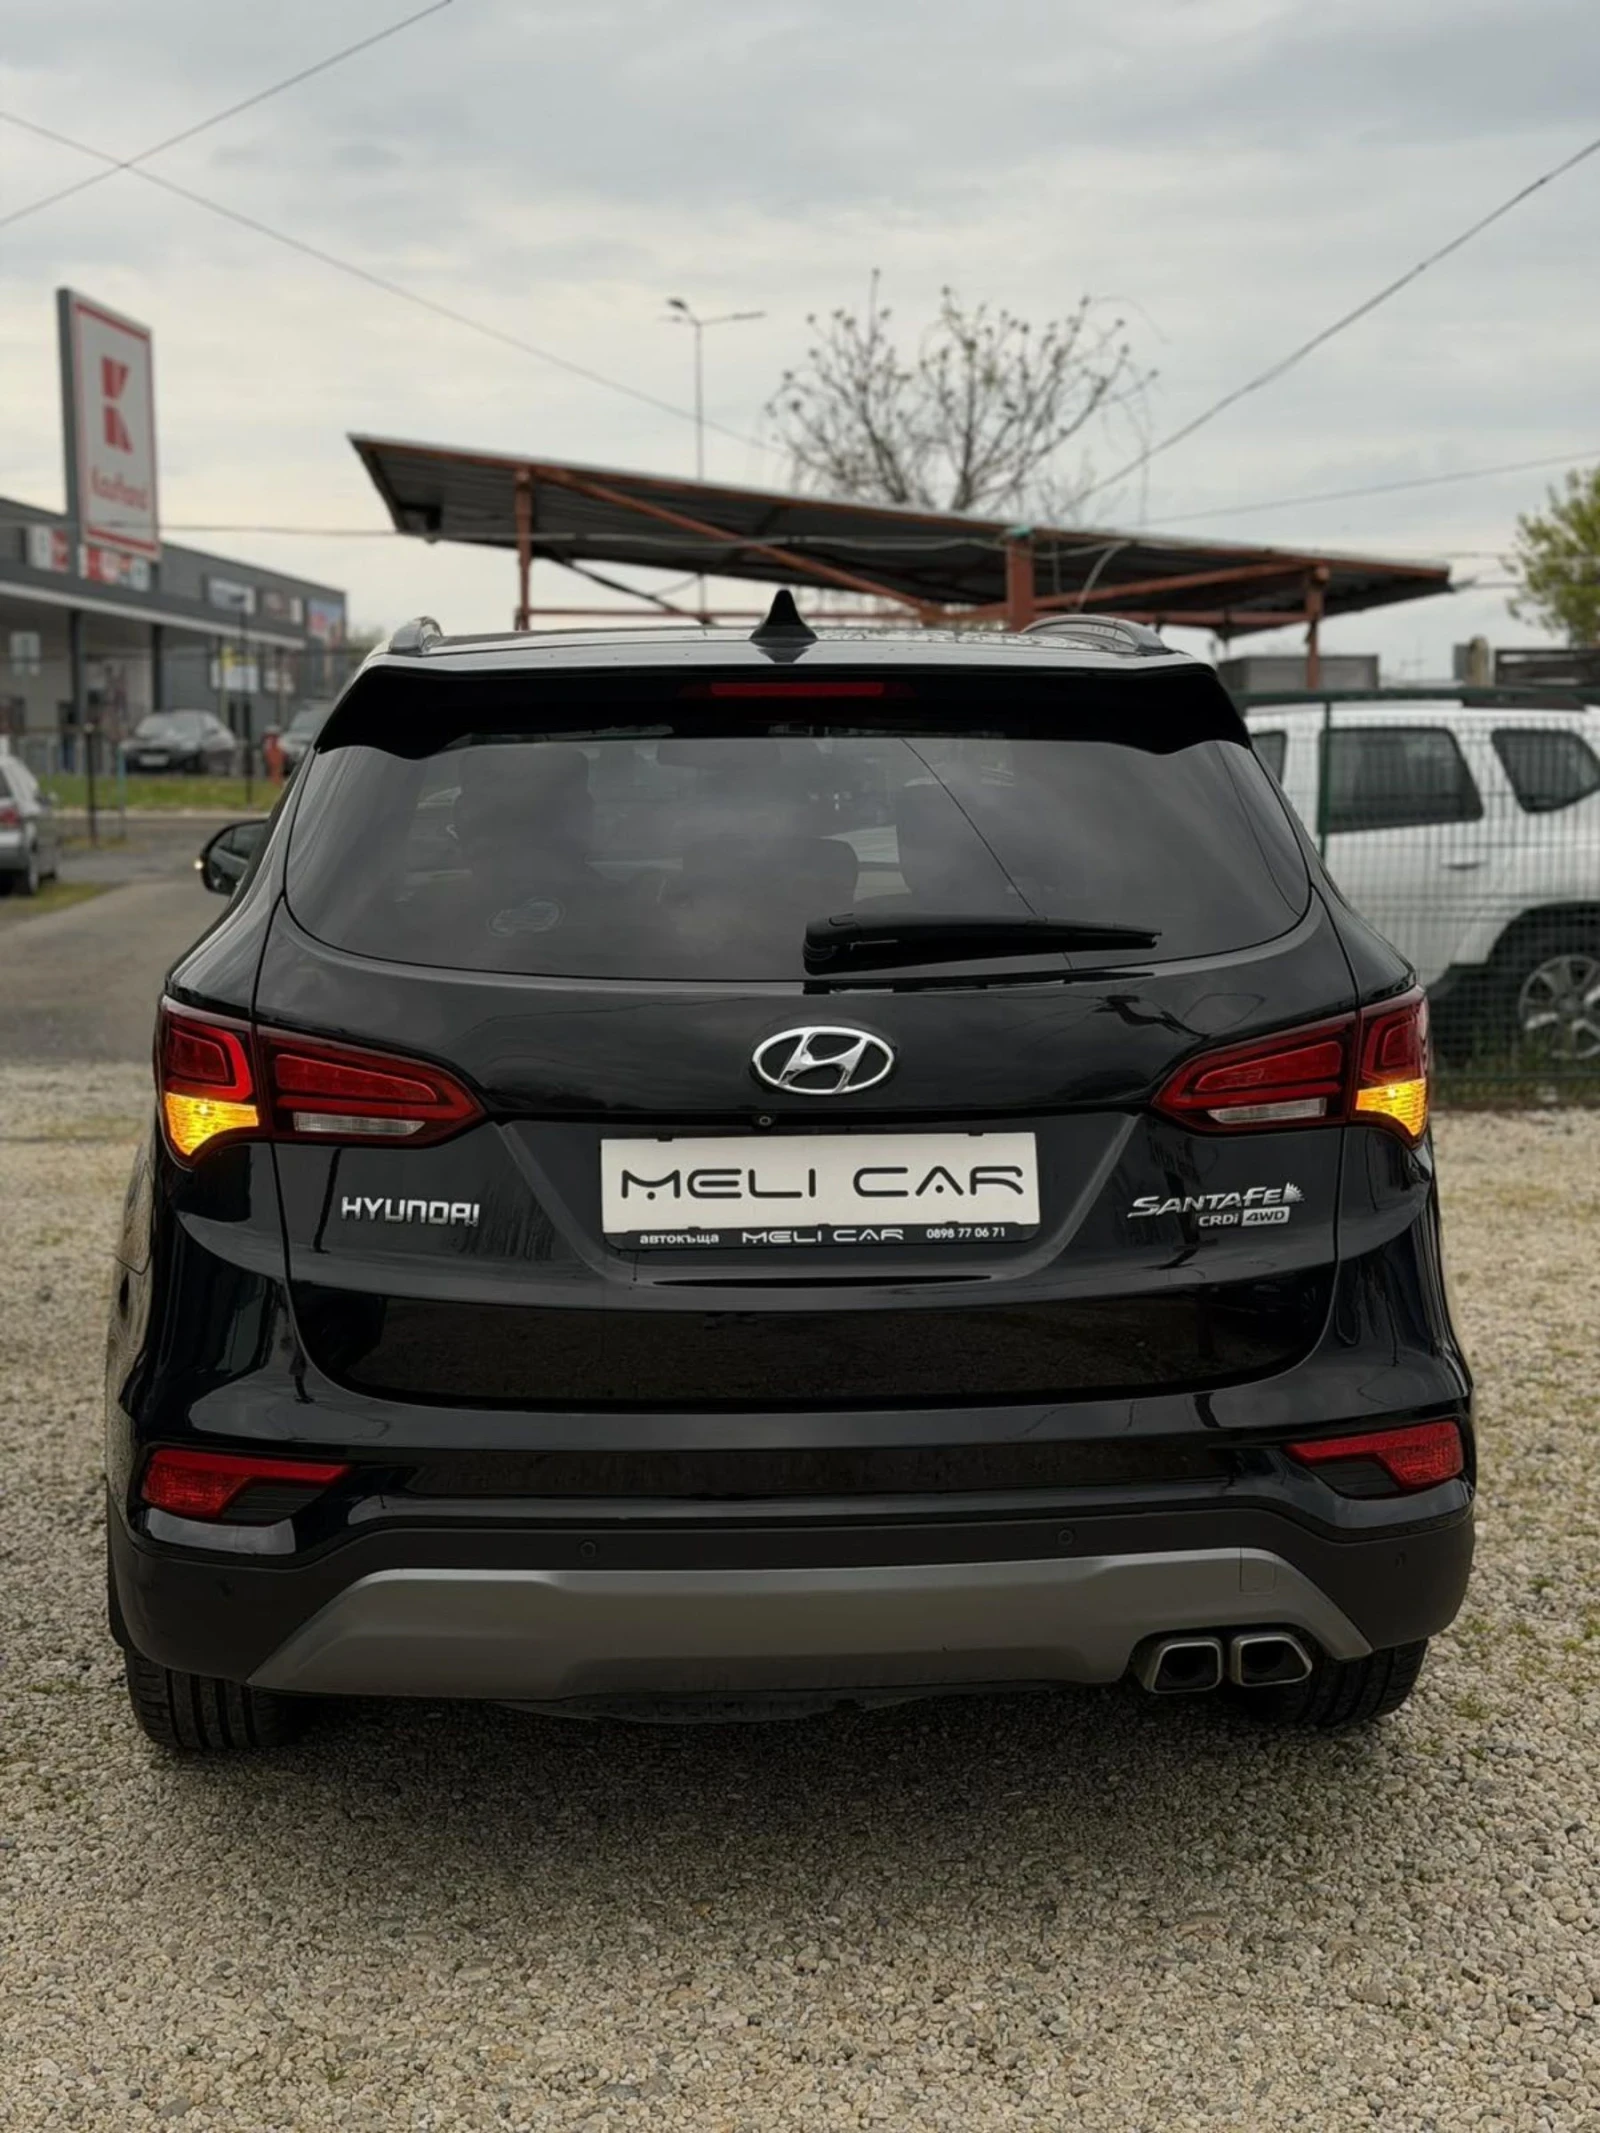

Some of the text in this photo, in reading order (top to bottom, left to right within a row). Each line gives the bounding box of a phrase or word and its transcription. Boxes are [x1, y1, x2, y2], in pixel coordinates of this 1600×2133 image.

[621, 1165, 1024, 1200] MELI CAR
[340, 1196, 481, 1227] HYUNDAI
[1198, 1207, 1290, 1227] CRDi 4WD
[639, 1233, 720, 1245] автокъща
[742, 1228, 904, 1244] MELI CAR
[926, 1226, 1005, 1239] 0898 77 06 71
